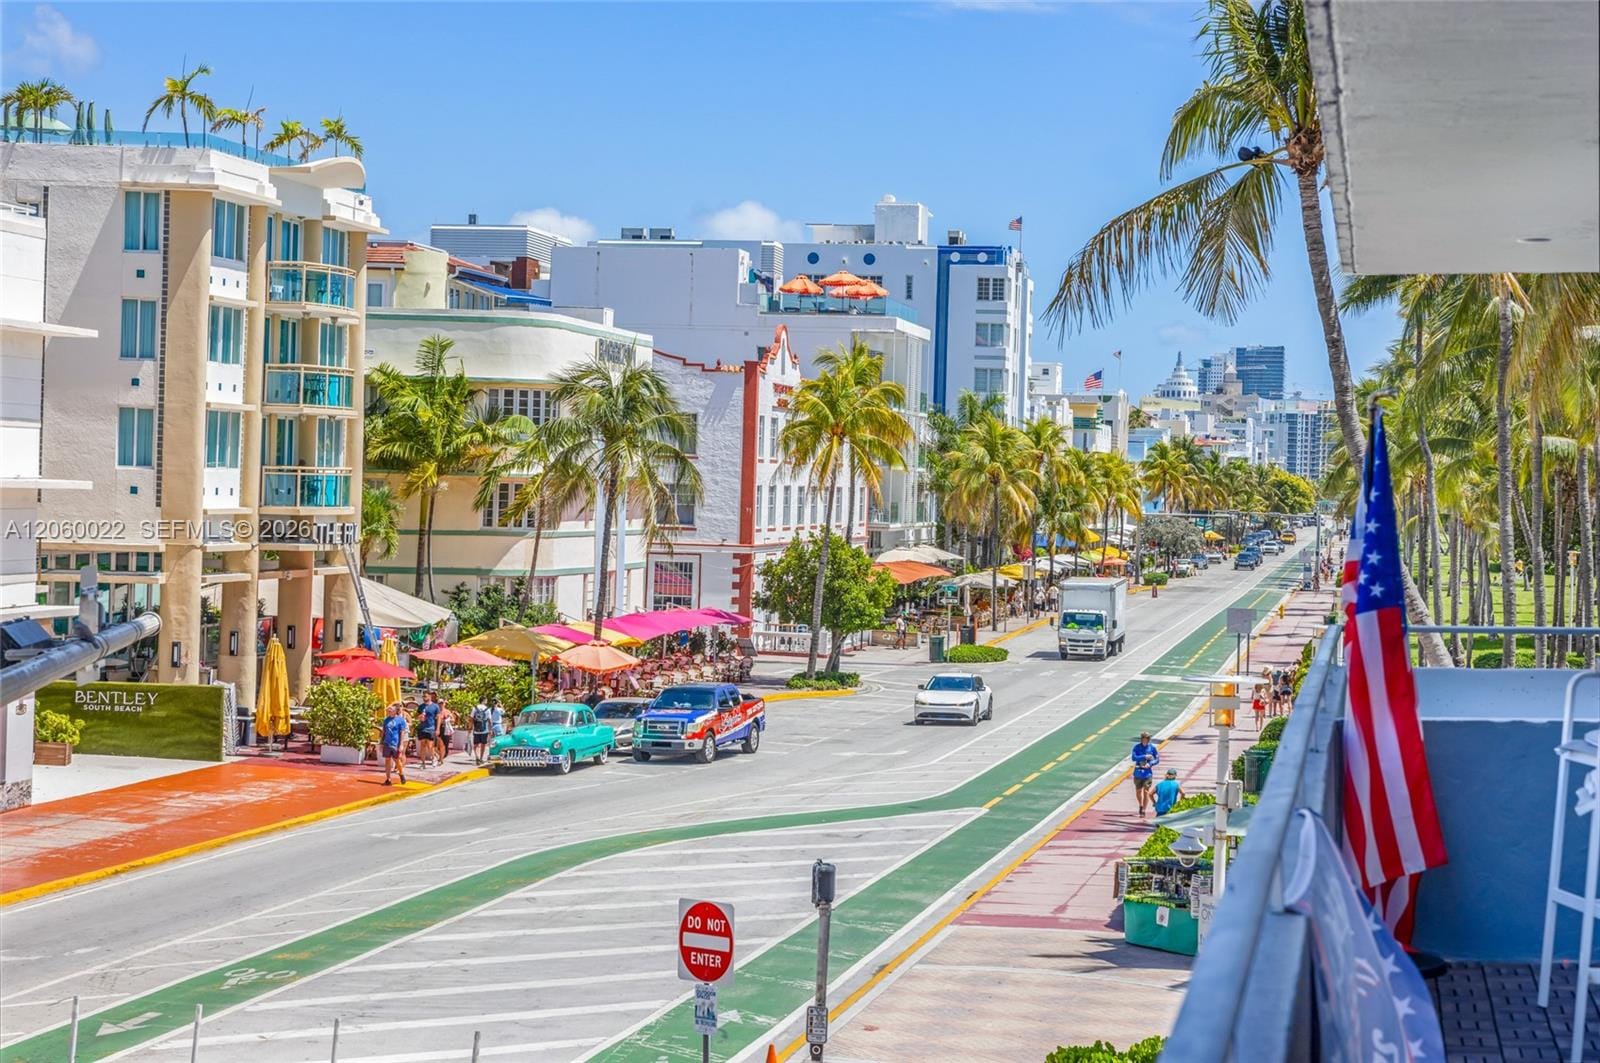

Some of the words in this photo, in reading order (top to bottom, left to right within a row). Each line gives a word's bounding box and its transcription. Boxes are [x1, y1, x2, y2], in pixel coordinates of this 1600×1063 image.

[75, 690, 159, 705] BENTLEY
[687, 915, 701, 929] DO
[707, 918, 726, 933] NOT
[690, 951, 722, 968] ENTER
